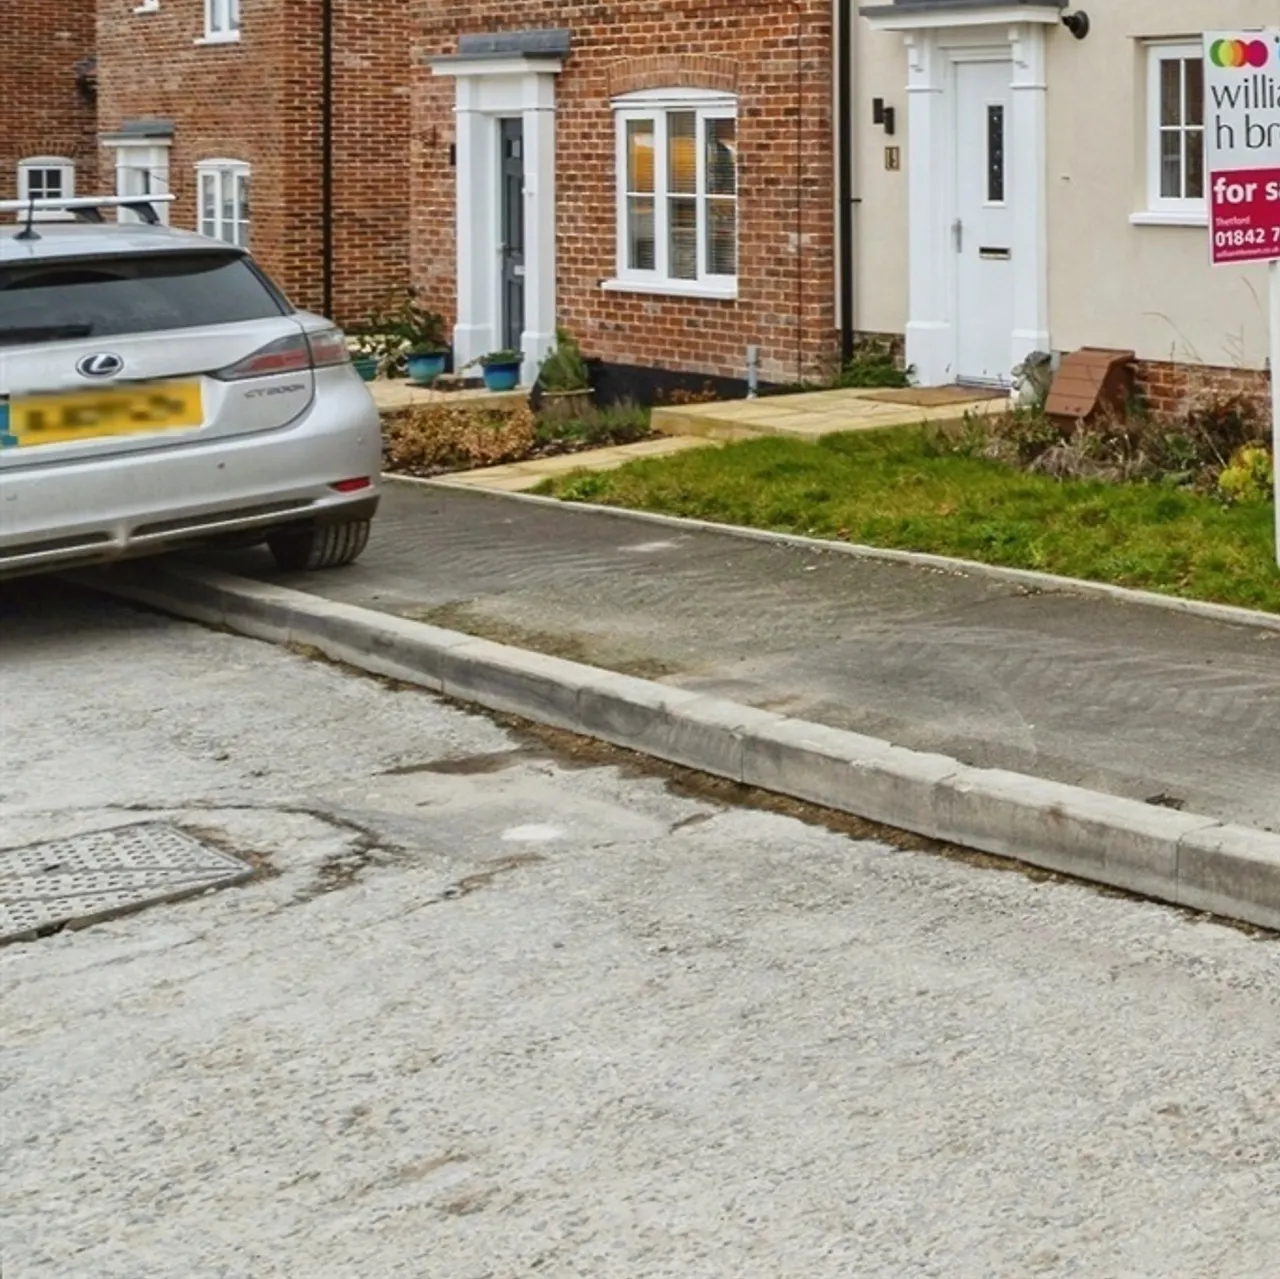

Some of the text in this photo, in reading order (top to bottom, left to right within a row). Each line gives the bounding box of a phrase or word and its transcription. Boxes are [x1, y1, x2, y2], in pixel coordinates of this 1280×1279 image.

[1215, 114, 1235, 150] h
[1213, 177, 1258, 205] for
[1215, 227, 1266, 248] 01842
